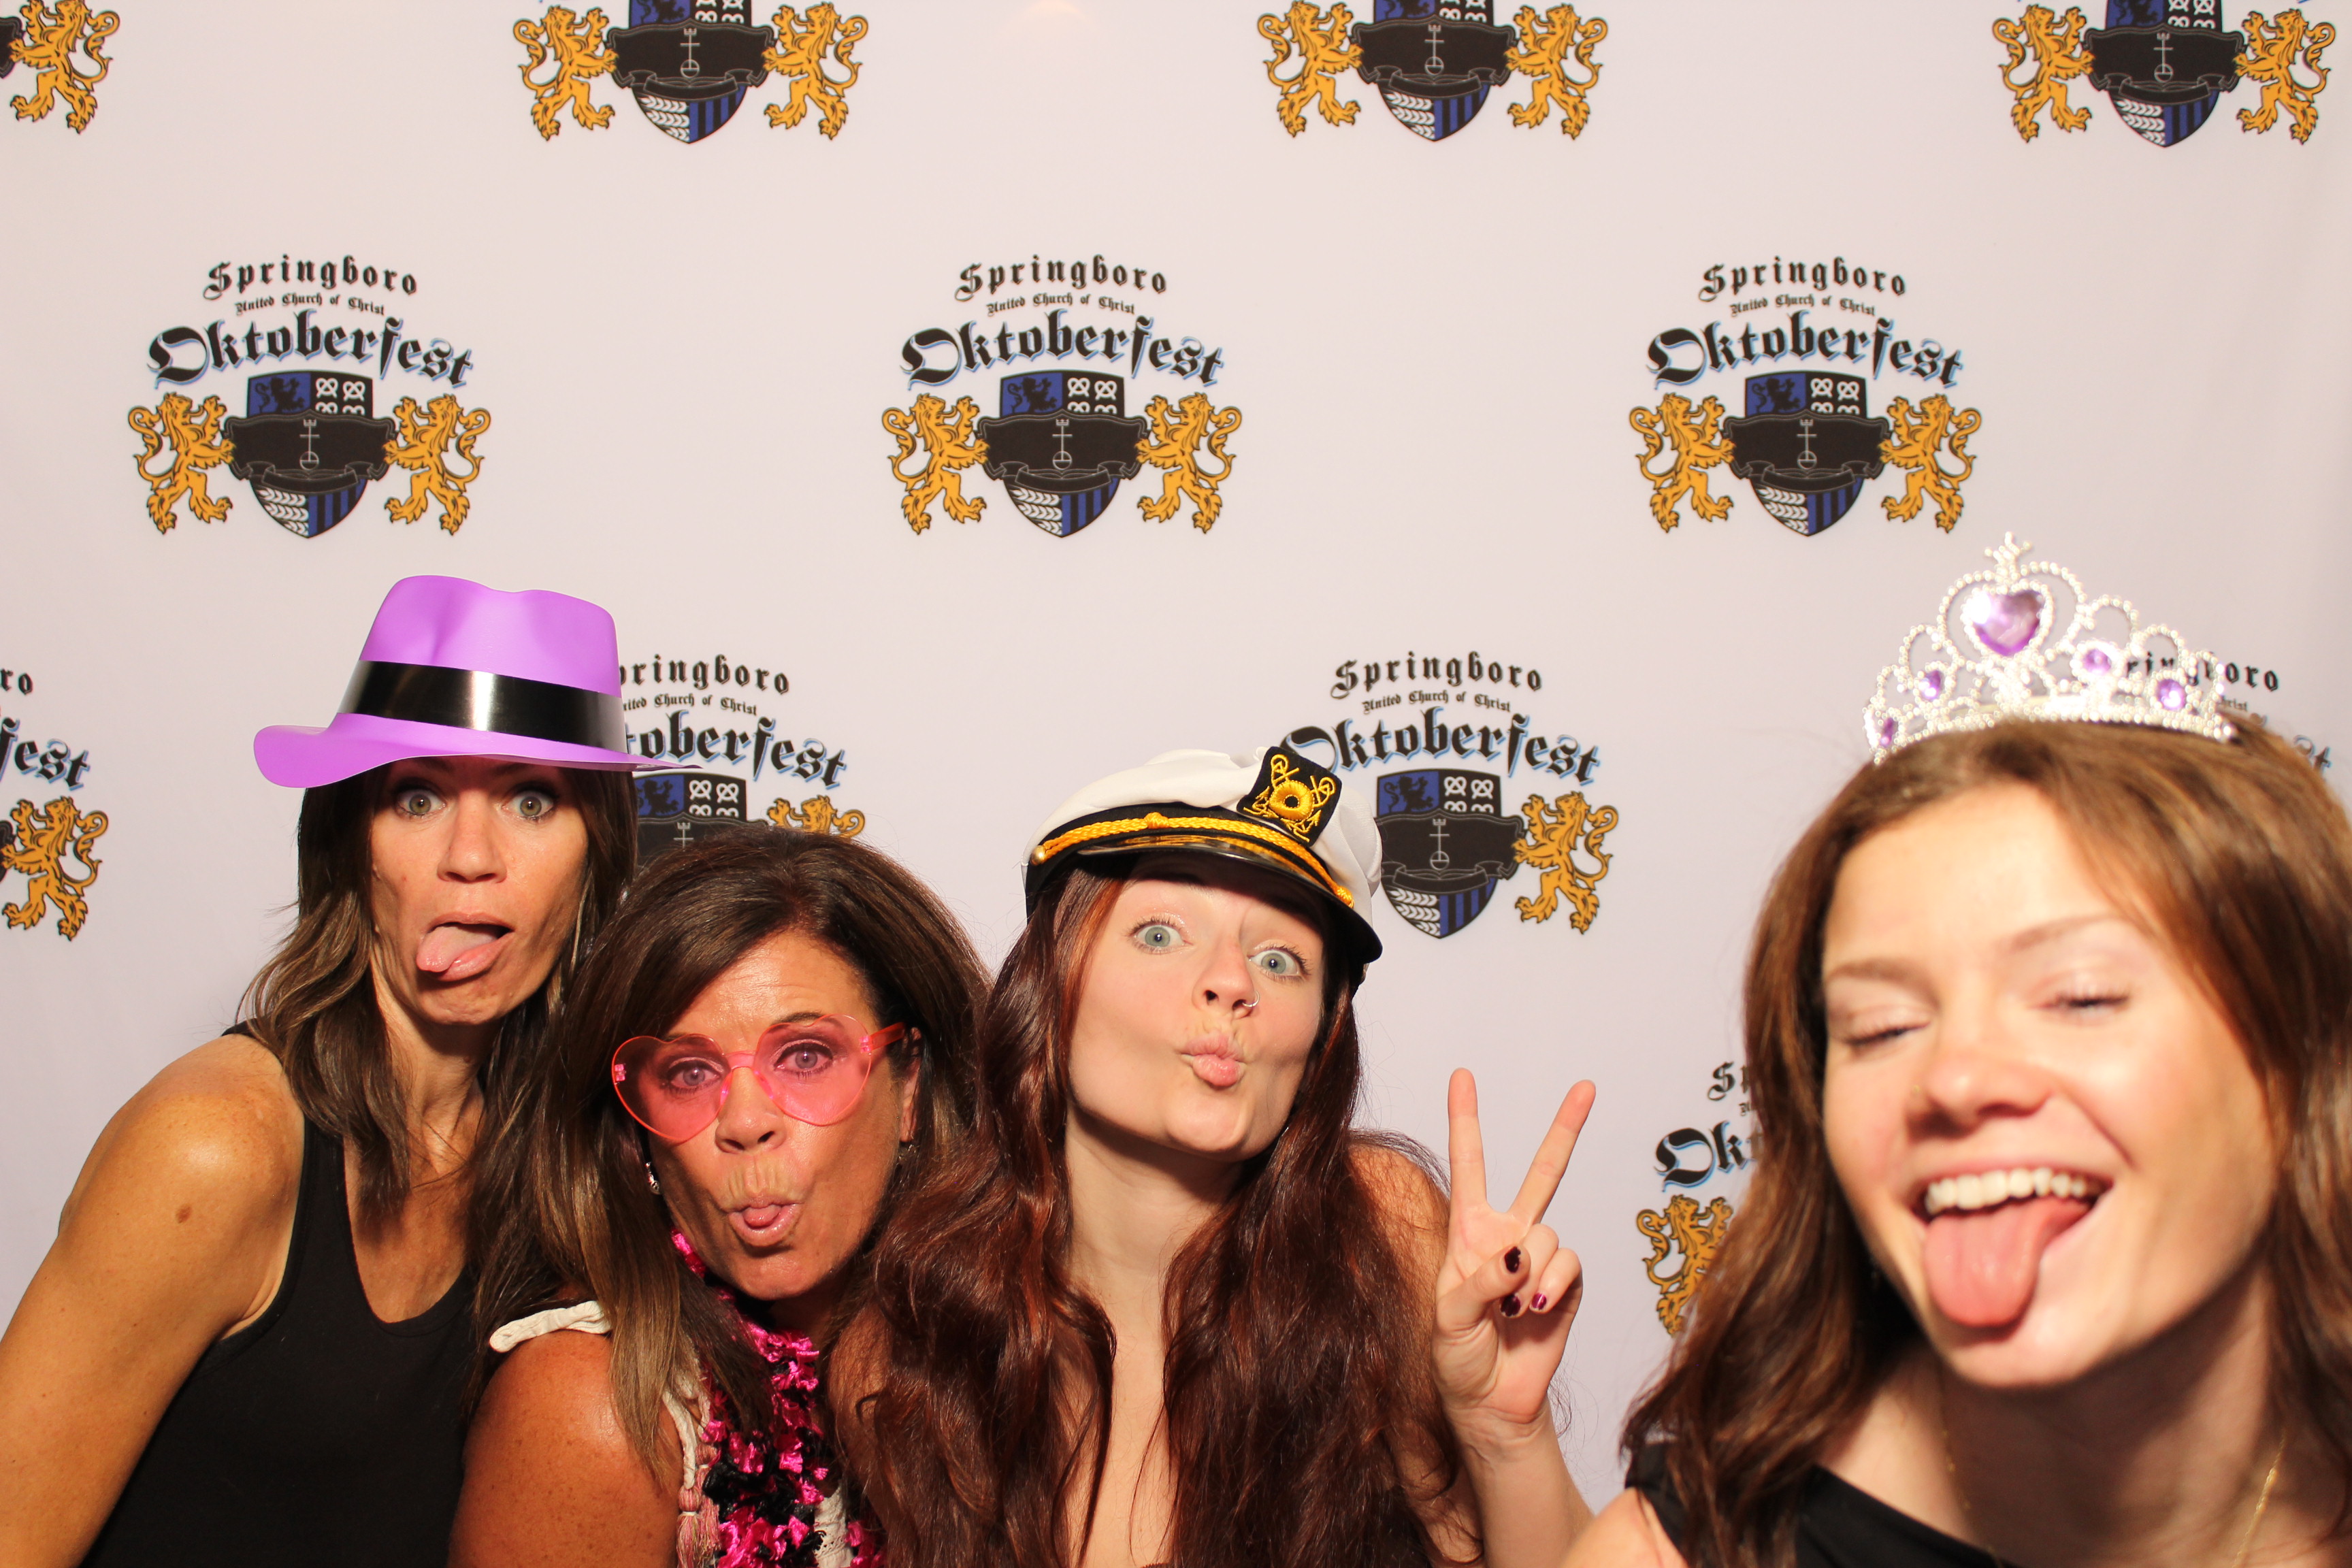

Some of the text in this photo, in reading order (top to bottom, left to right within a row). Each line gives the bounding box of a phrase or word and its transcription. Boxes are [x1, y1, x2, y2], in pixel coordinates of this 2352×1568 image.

[203, 254, 417, 301] Springboro
[954, 254, 1167, 302] Springboro
[1697, 255, 1906, 303] Springboro
[234, 292, 385, 316] United Church of Christ
[985, 292, 1135, 317] United Church of Christ
[1729, 293, 1876, 318] United Church of Christ
[146, 308, 473, 389] Oktoberfest
[900, 308, 1225, 391] Oktoberfest
[1646, 309, 1964, 390] Oktoberfest
[1330, 651, 1543, 700] Springboro
[654, 692, 695, 708] Church
[701, 694, 713, 706] of
[719, 696, 757, 717] Christ
[1361, 689, 1511, 715] United Church of Christ
